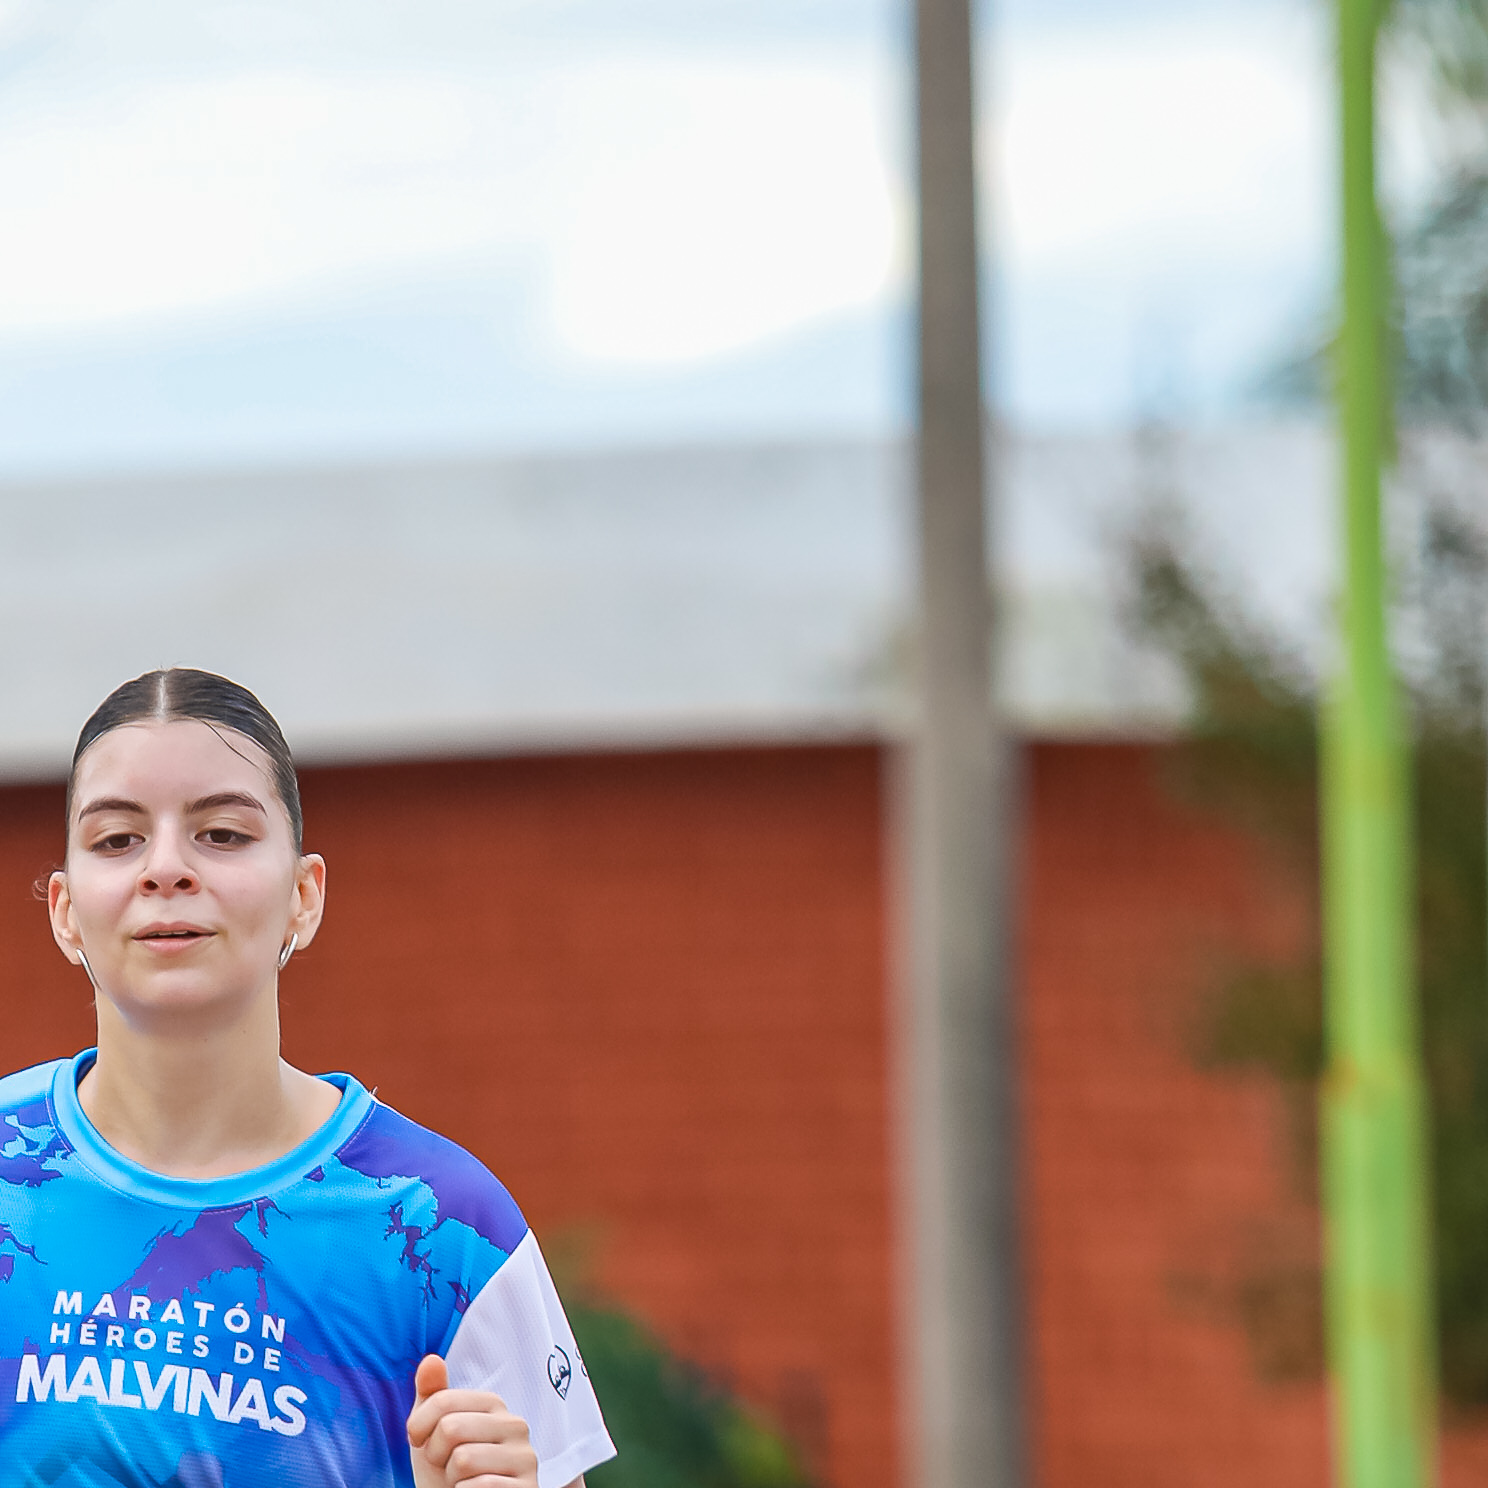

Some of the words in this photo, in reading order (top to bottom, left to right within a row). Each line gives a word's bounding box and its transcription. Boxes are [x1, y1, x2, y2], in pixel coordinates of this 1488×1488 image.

[53, 1291, 285, 1343] MARATÓN
[50, 1319, 209, 1358] HÉROES
[233, 1341, 281, 1372] DE
[16, 1354, 308, 1436] MALVINAS
